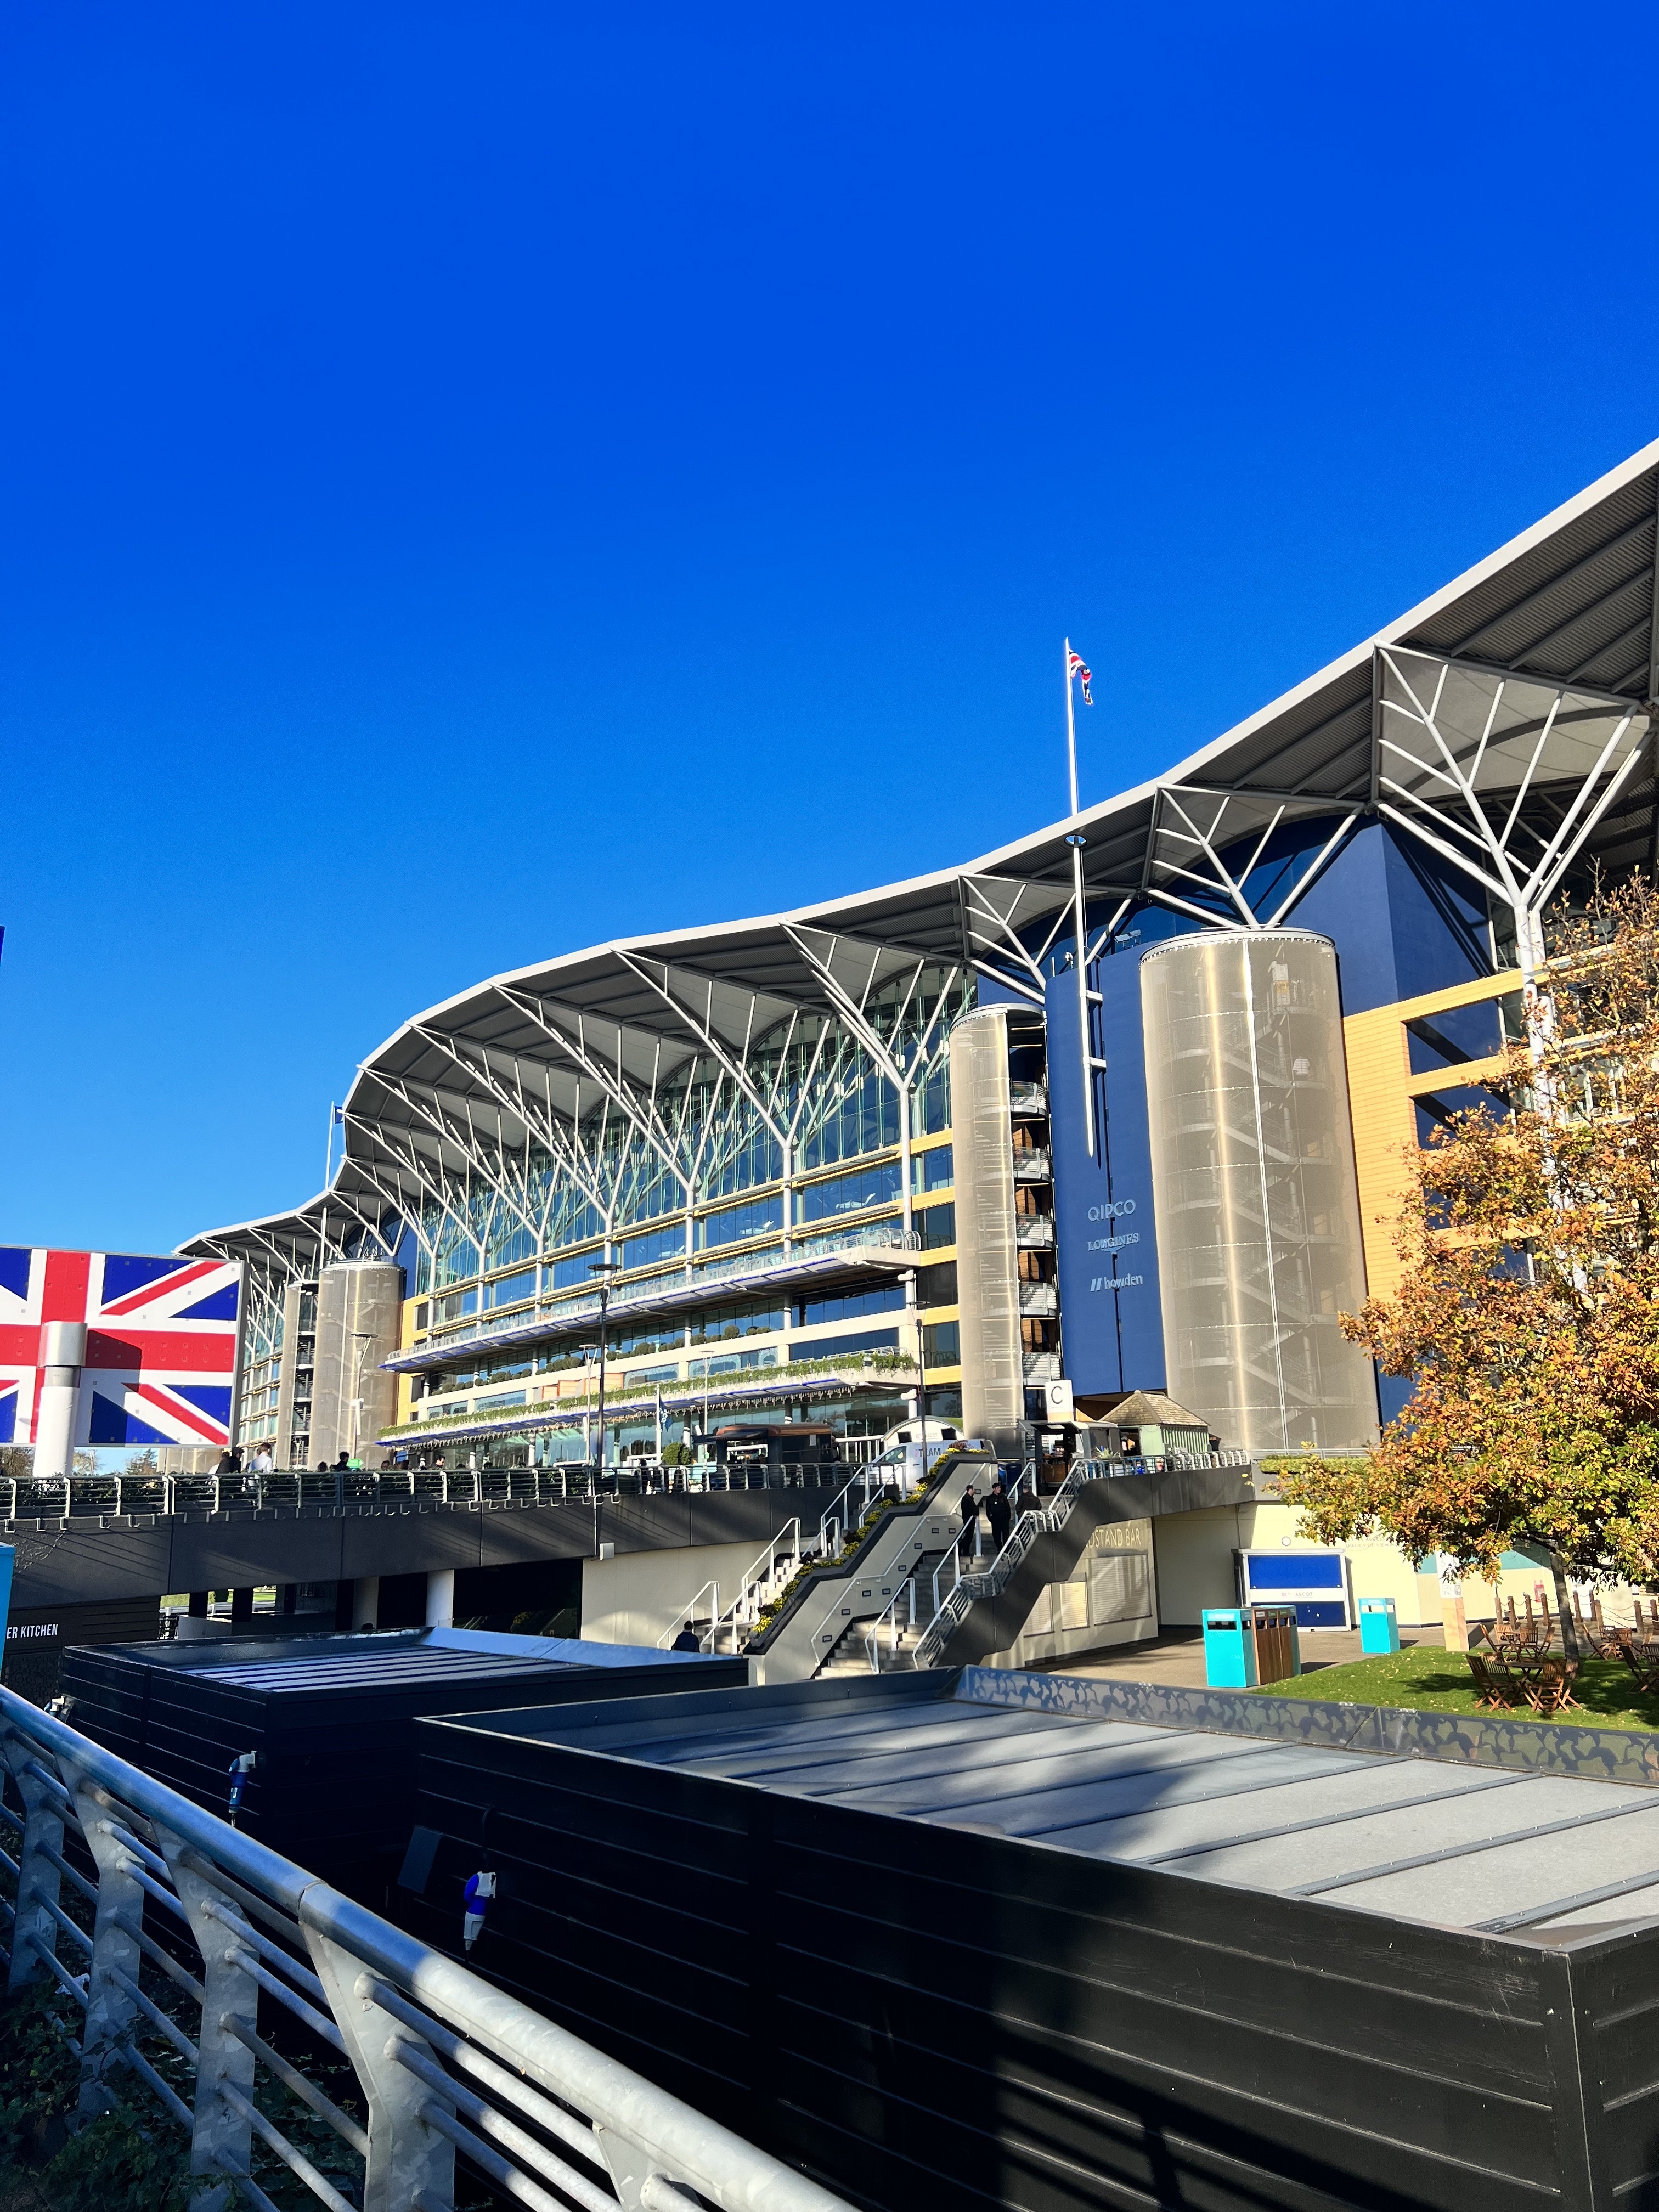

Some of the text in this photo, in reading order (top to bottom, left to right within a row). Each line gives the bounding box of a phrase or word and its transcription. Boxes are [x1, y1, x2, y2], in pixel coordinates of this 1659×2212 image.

[1088, 1199, 1137, 1222] QIPCO
[1087, 1233, 1139, 1251] LONGINES
[1104, 1273, 1143, 1289] howden
[1051, 1386, 1063, 1404] C
[918, 1448, 941, 1457] TAM
[1086, 1528, 1141, 1548] DSTAND BAR
[20, 1623, 58, 1638] KITCHEN
